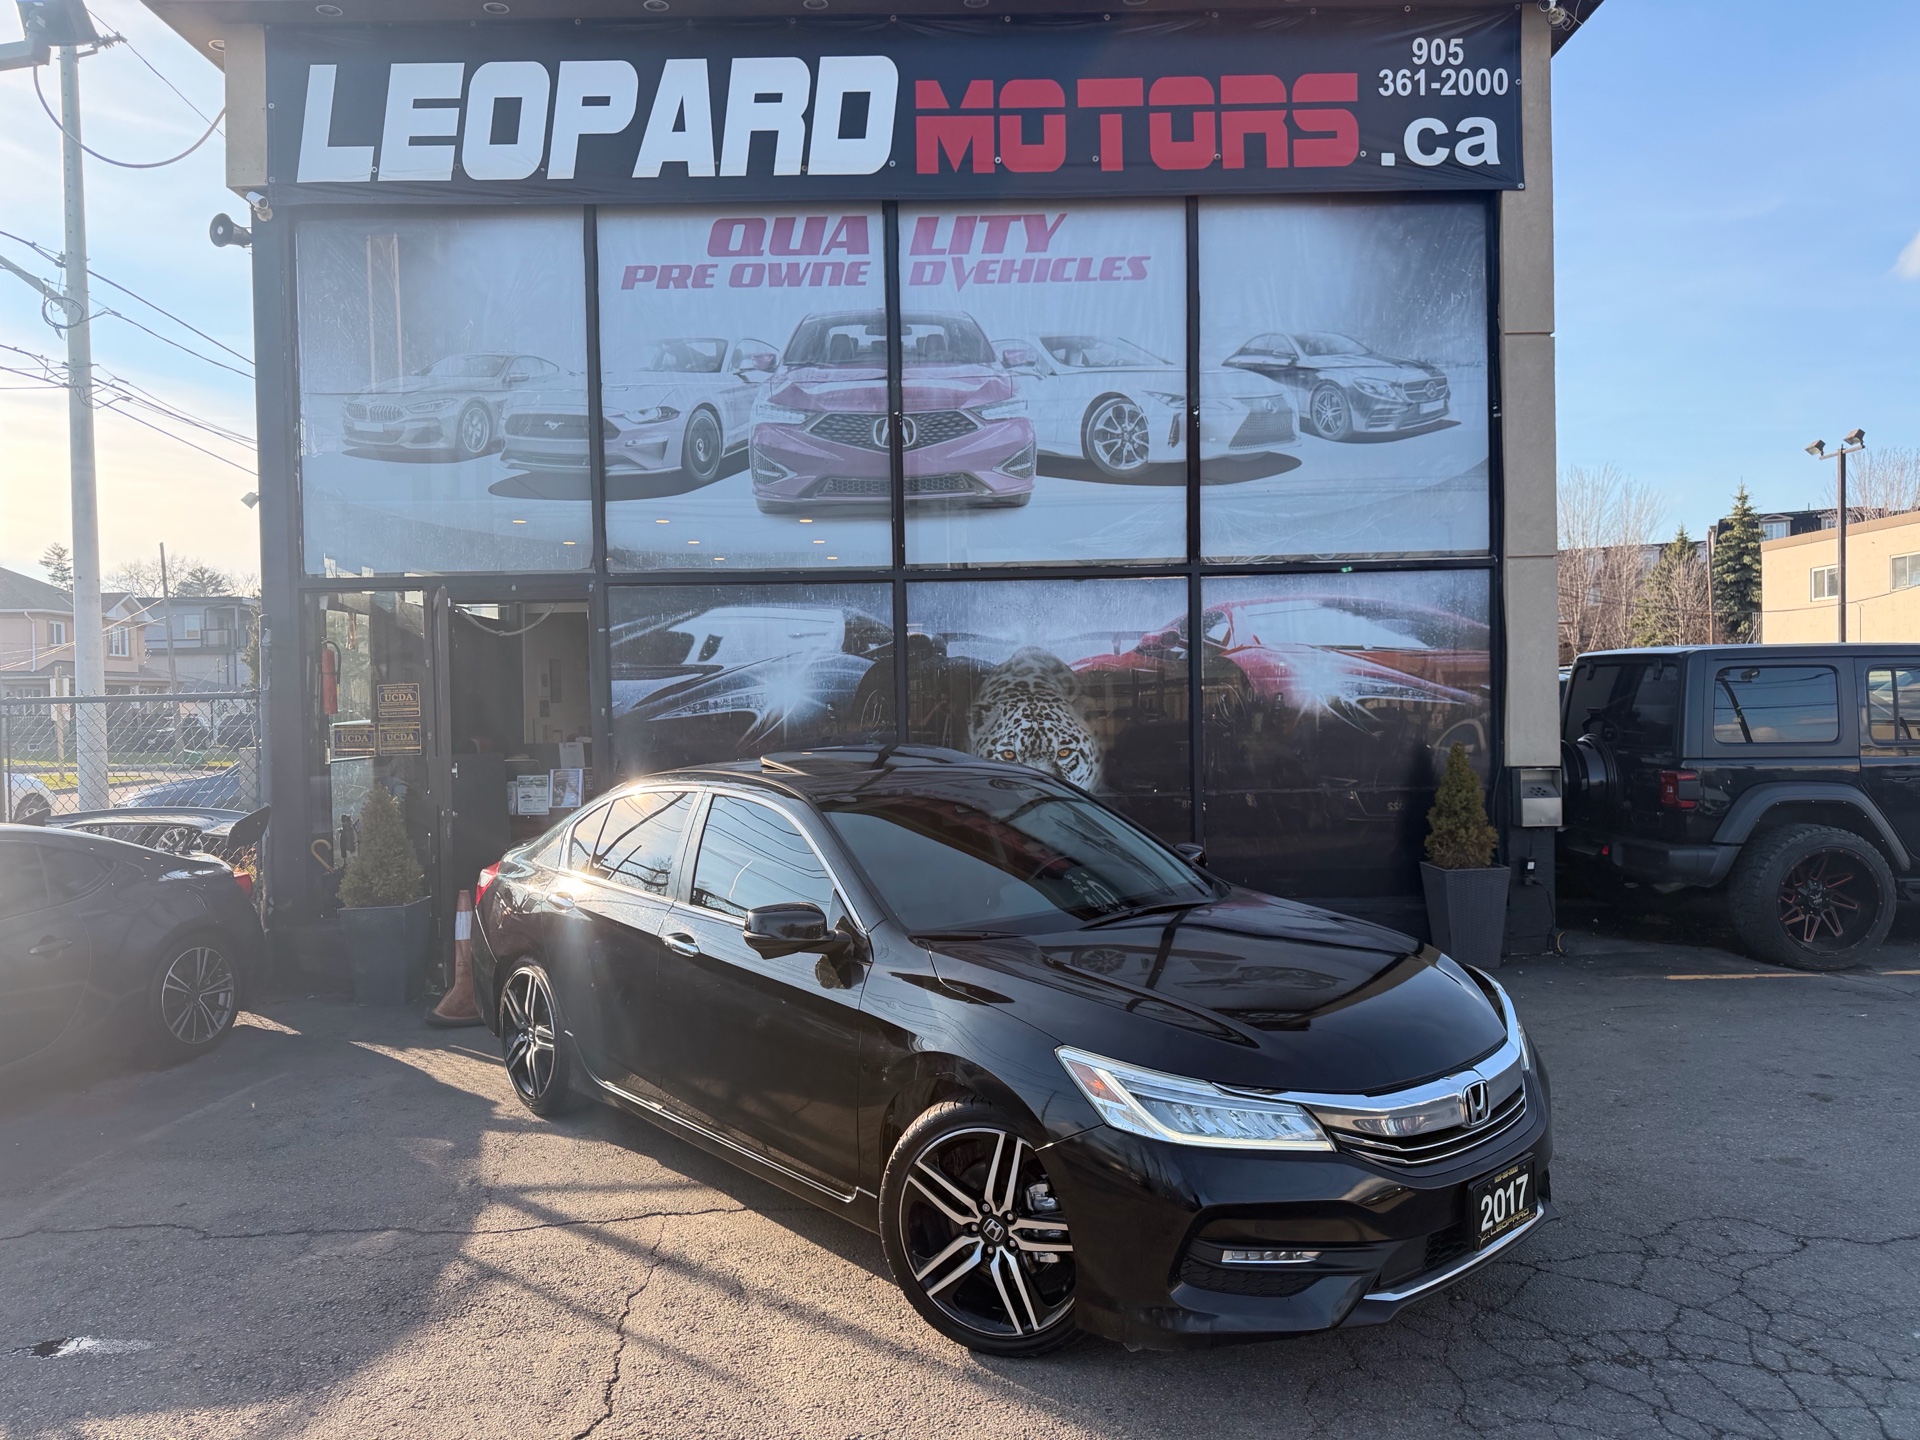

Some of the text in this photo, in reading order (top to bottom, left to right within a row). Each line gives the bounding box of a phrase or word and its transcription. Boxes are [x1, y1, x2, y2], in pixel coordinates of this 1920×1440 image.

[1412, 37, 1464, 66] 905
[1378, 68, 1509, 96] 361-2000
[296, 55, 1359, 184] LEOPARD MOTORS
[1380, 116, 1501, 167] .ca
[707, 213, 1068, 257] QUA LITY
[620, 263, 719, 290] PRE
[728, 261, 871, 288] OWNE
[384, 693, 413, 702] UCDA
[341, 734, 369, 742] UCDA
[386, 733, 414, 741] UCDA
[1481, 1173, 1529, 1232] 2017
[1490, 1207, 1530, 1236] LEOPARD
